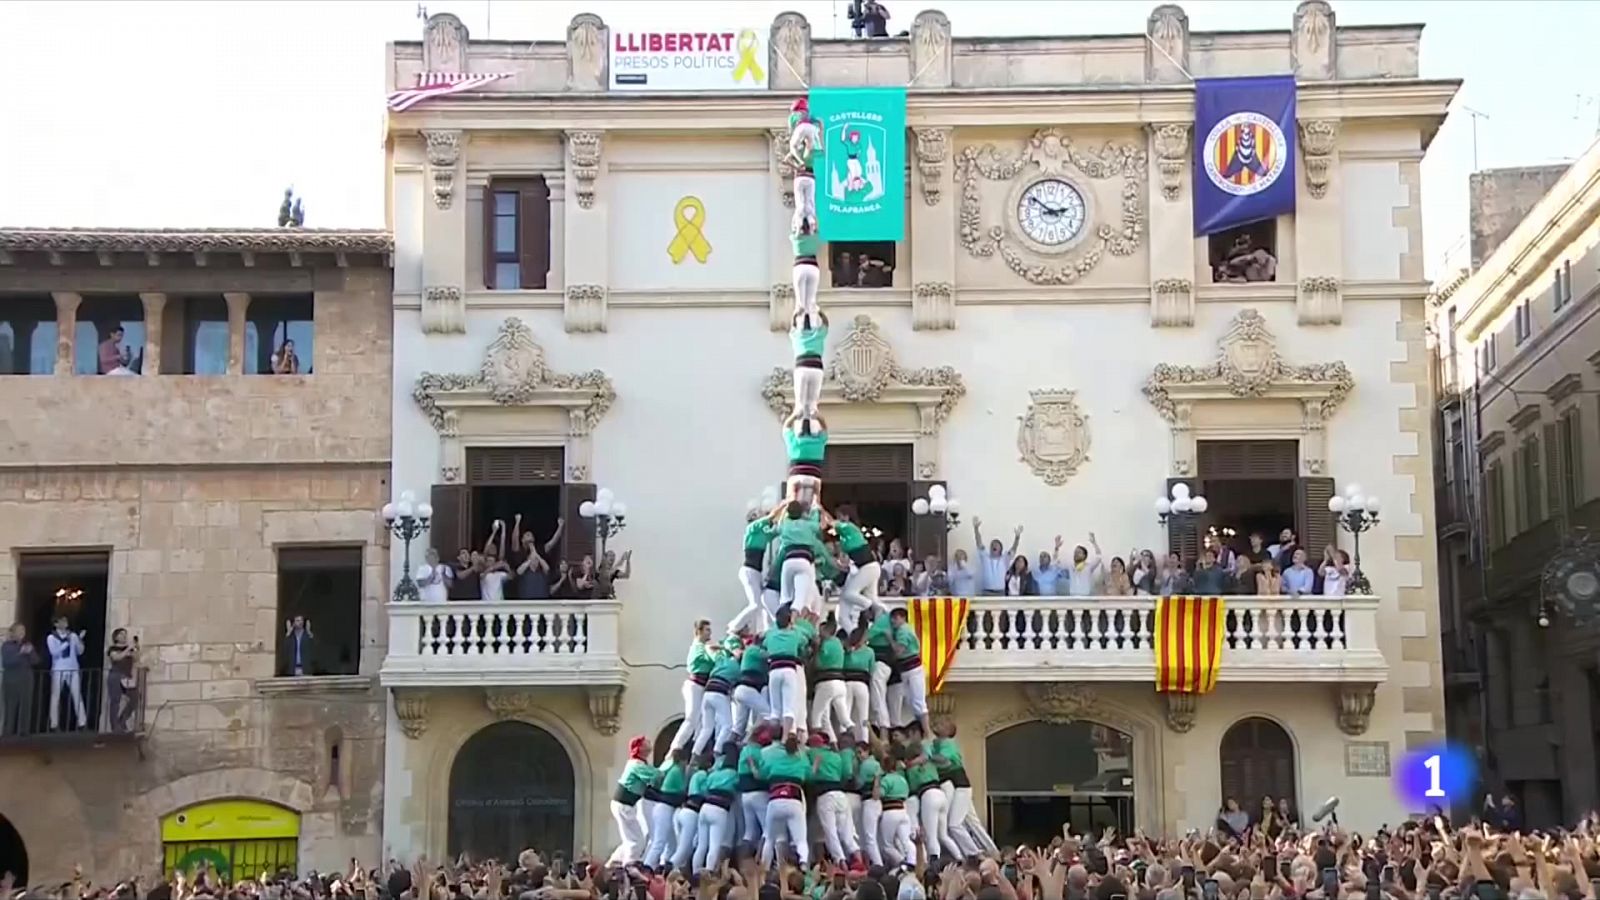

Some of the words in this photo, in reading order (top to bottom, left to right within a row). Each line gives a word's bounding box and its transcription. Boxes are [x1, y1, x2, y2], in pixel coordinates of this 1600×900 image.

[615, 33, 735, 52] LLIBERTAT
[614, 56, 669, 68] PRESOS
[674, 53, 736, 68] POLÍTICS
[829, 111, 883, 123] CASTELLERS
[829, 202, 881, 214] VILAFRANCA
